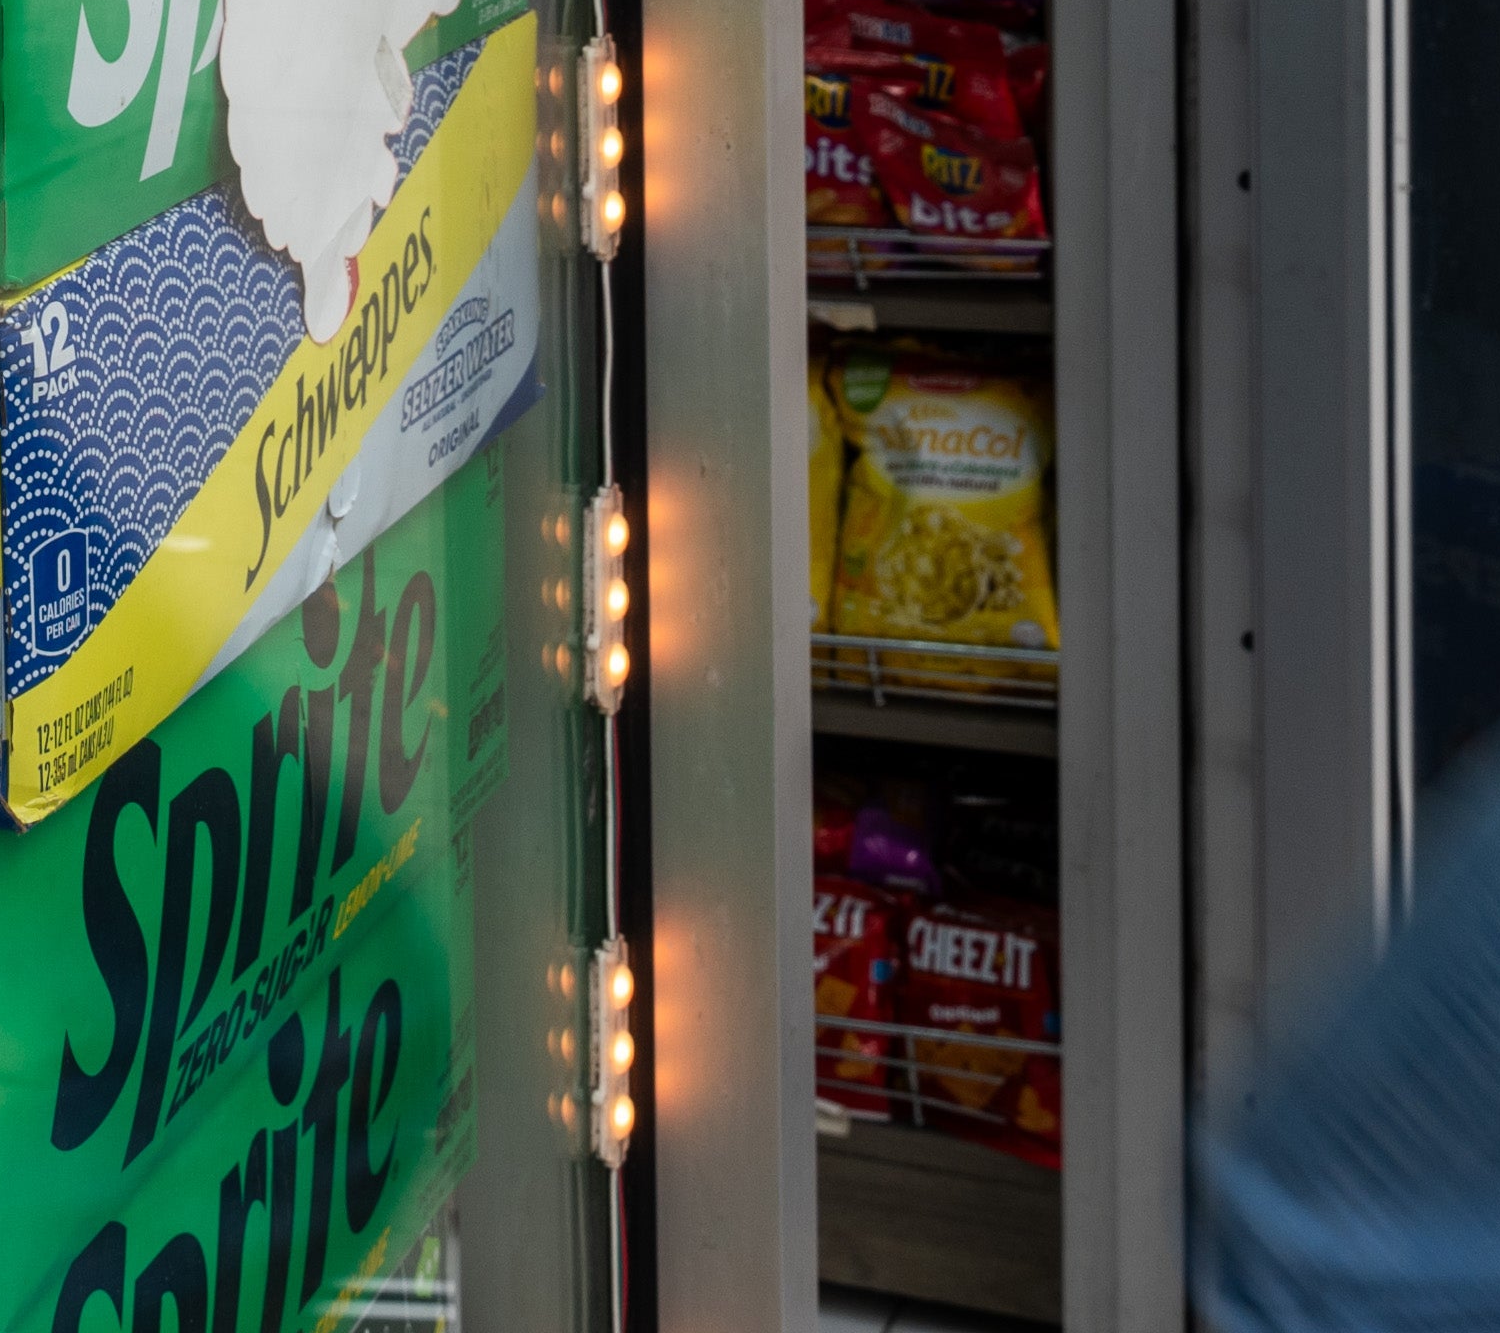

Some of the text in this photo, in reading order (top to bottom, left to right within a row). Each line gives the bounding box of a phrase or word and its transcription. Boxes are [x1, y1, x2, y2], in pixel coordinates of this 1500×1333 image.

[20, 302, 75, 377] 12
[401, 308, 514, 432] SELTZER WATER
[32, 367, 79, 405] PACK
[245, 207, 434, 592] Schweppes
[428, 407, 479, 467] ORIGINAL
[39, 586, 84, 624] CALORIES
[56, 549, 71, 592] 0
[50, 545, 436, 1172] Sprite
[165, 894, 335, 1128] ZERO SUGAR
